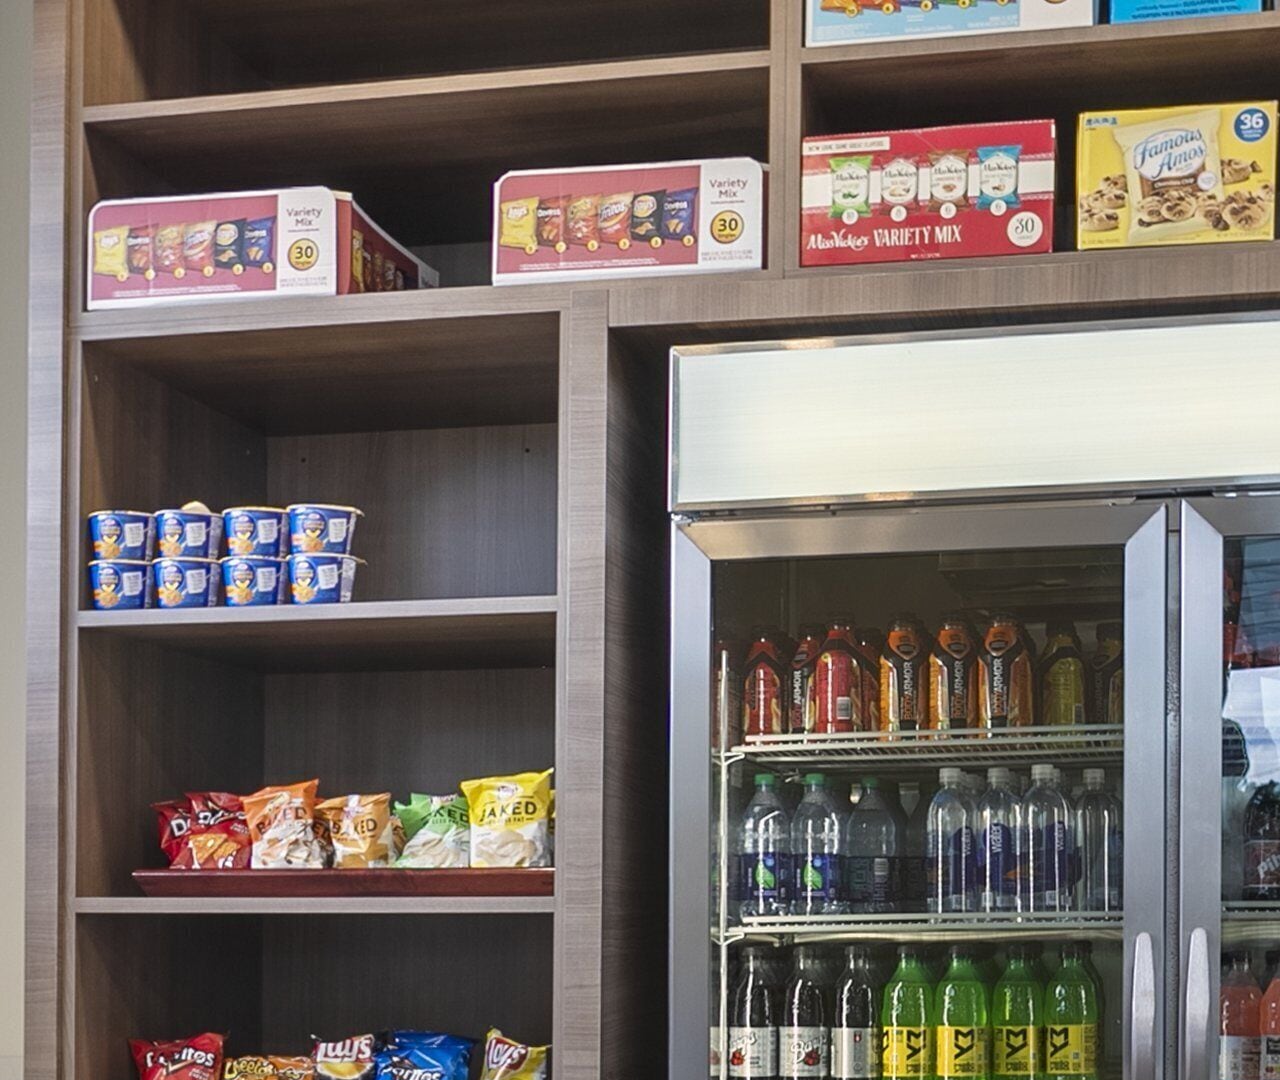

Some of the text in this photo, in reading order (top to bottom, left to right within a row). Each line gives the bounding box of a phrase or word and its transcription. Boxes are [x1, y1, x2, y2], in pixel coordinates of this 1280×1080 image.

[1240, 113, 1264, 129] 36
[1134, 128, 1203, 169] Famous
[1151, 145, 1205, 179] Amos
[709, 179, 748, 191] Variety
[718, 189, 738, 198] Mix
[286, 207, 323, 220] Variety
[295, 218, 313, 227] Mix
[717, 217, 738, 232] 30
[1015, 218, 1035, 234] 30
[873, 225, 931, 247] VARIETY
[934, 225, 962, 244] MIX
[294, 245, 314, 260] 30
